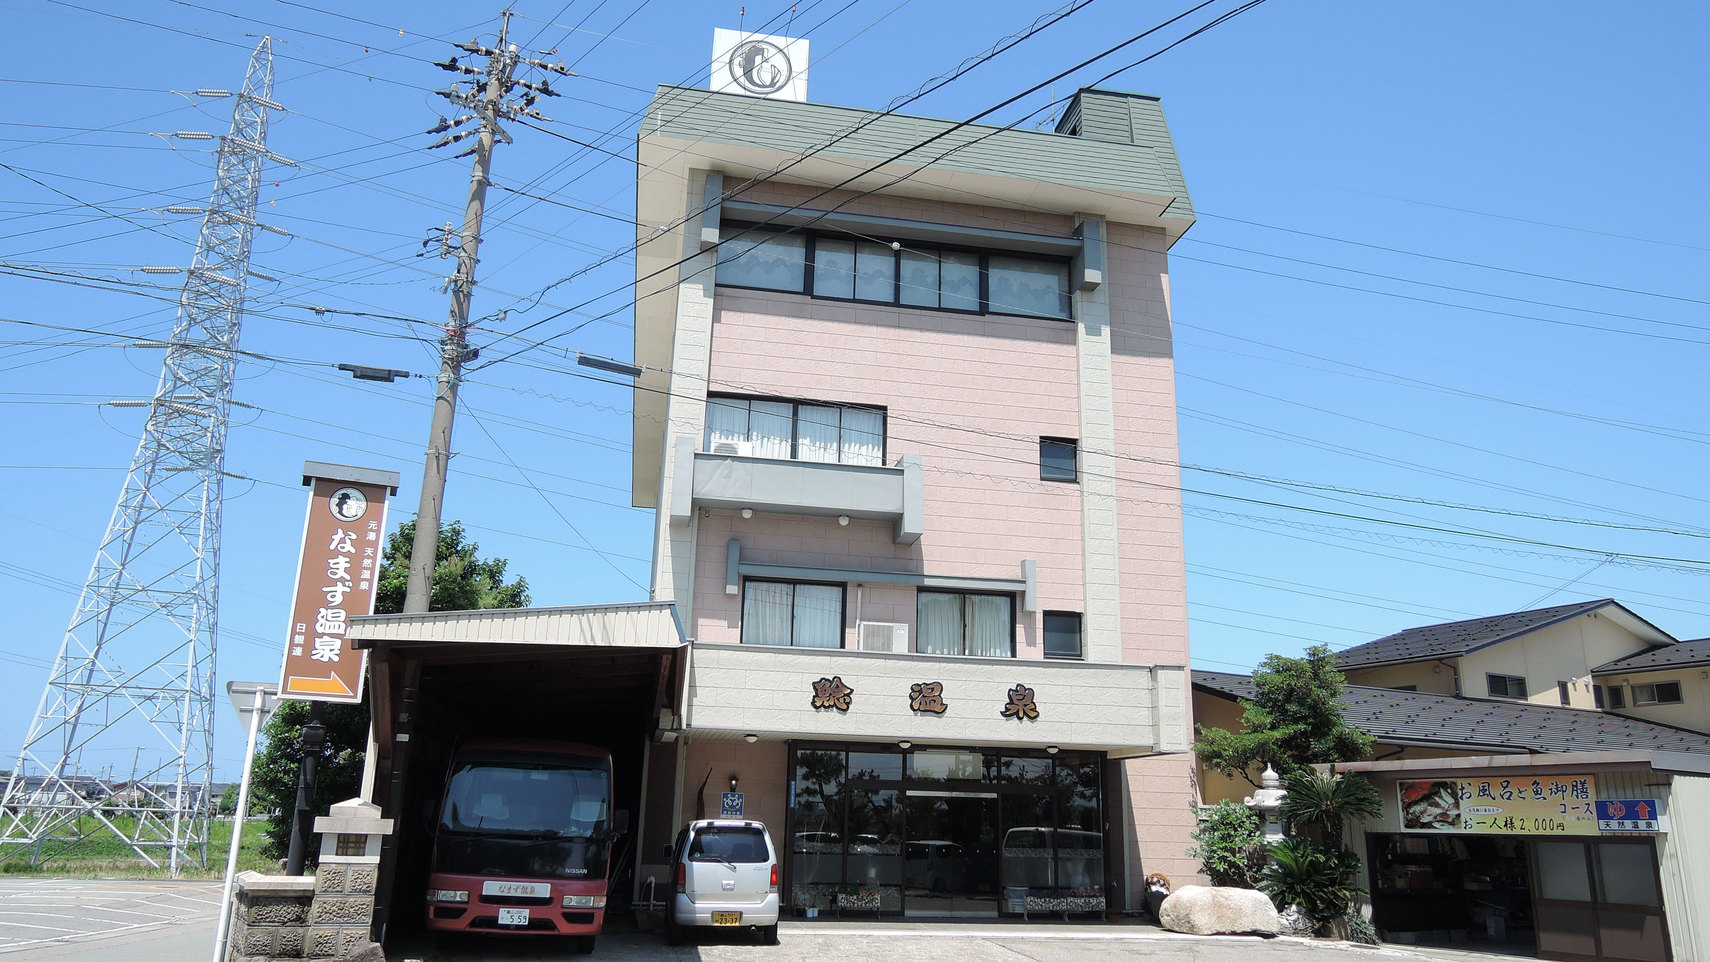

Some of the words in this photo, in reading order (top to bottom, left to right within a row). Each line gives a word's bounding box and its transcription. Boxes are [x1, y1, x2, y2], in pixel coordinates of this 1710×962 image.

[366, 520, 378, 541] 元湯
[358, 547, 374, 590] 天然温泉
[310, 527, 358, 663] なまず温泉
[1458, 778, 1591, 801] お風呂と魚御膳
[1559, 802, 1594, 816] コース
[1606, 800, 1626, 820] ゆ
[1603, 820, 1654, 830] 天然温泉
